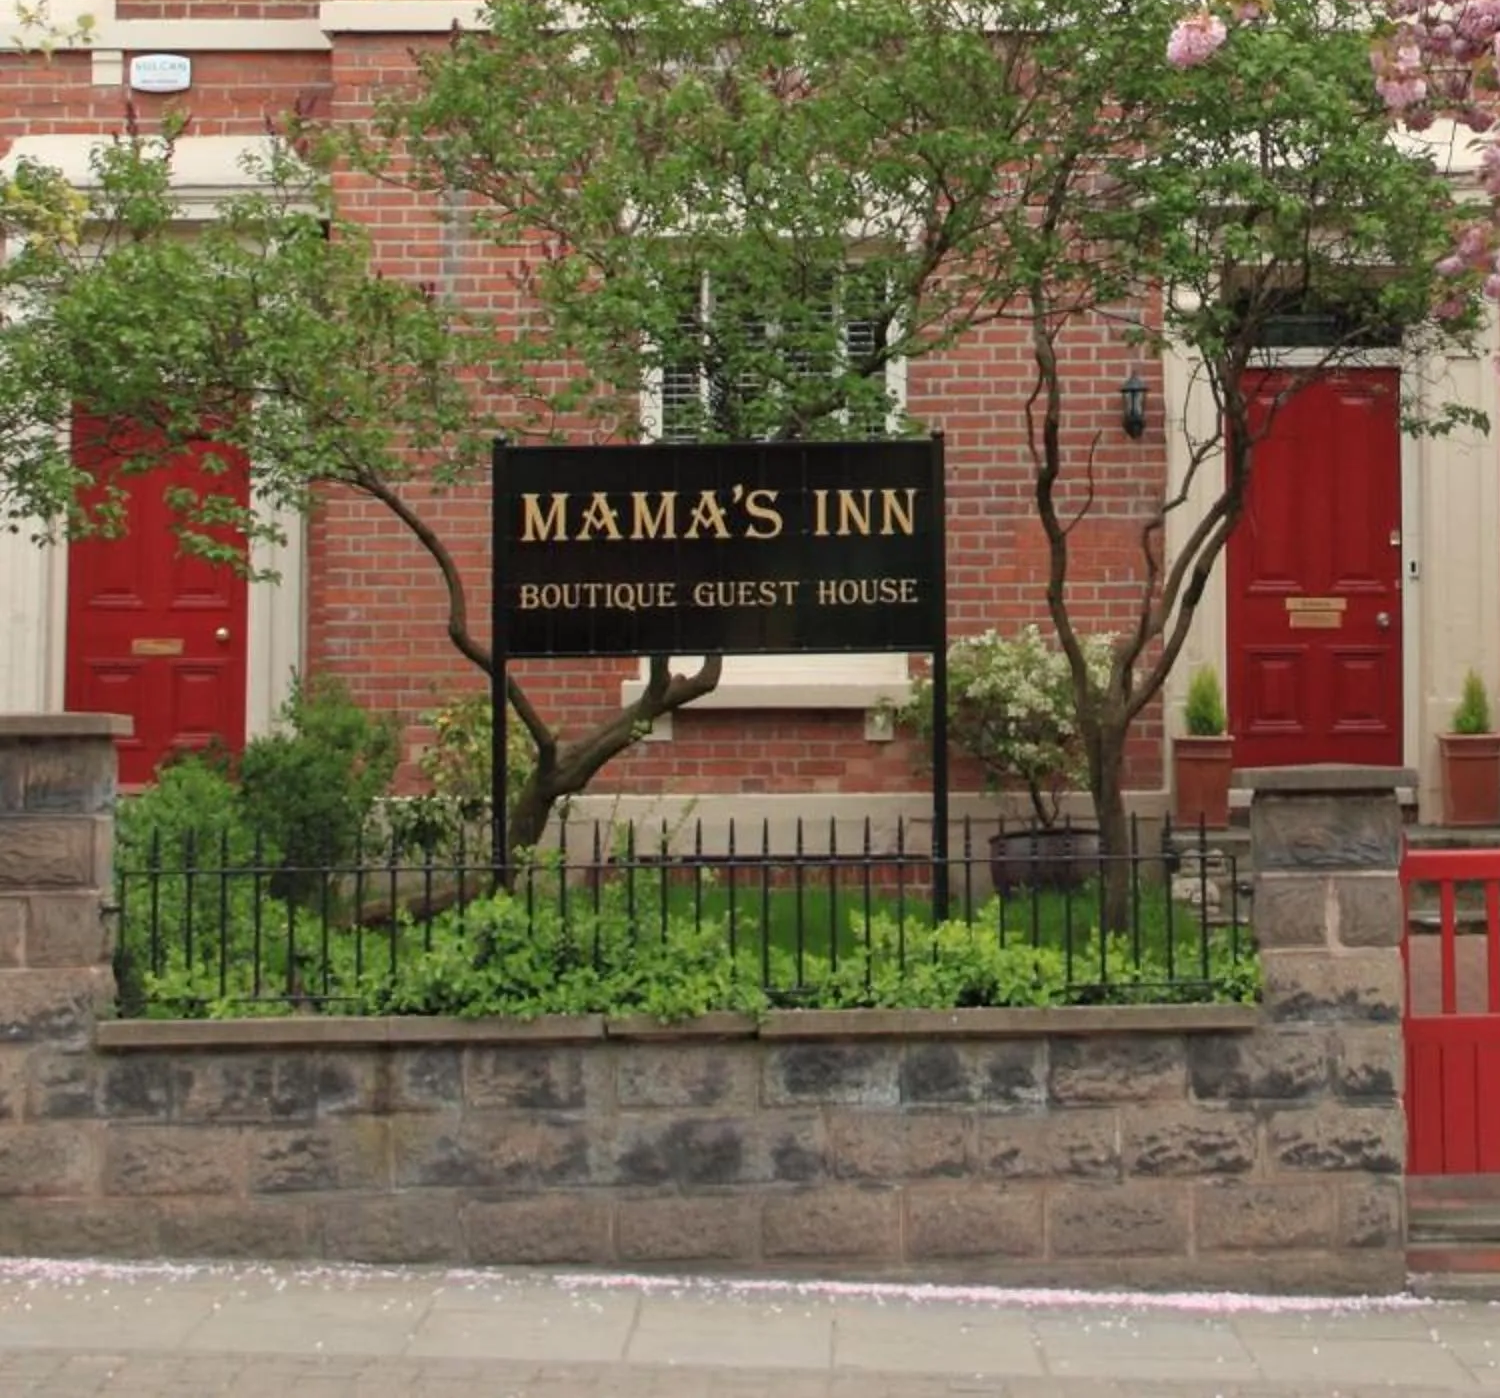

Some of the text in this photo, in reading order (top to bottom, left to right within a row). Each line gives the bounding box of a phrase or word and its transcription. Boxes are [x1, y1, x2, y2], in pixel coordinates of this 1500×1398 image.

[520, 483, 918, 542] MAMA'S INN
[519, 578, 919, 611] BOUTIQUE GUEST HOUSE
